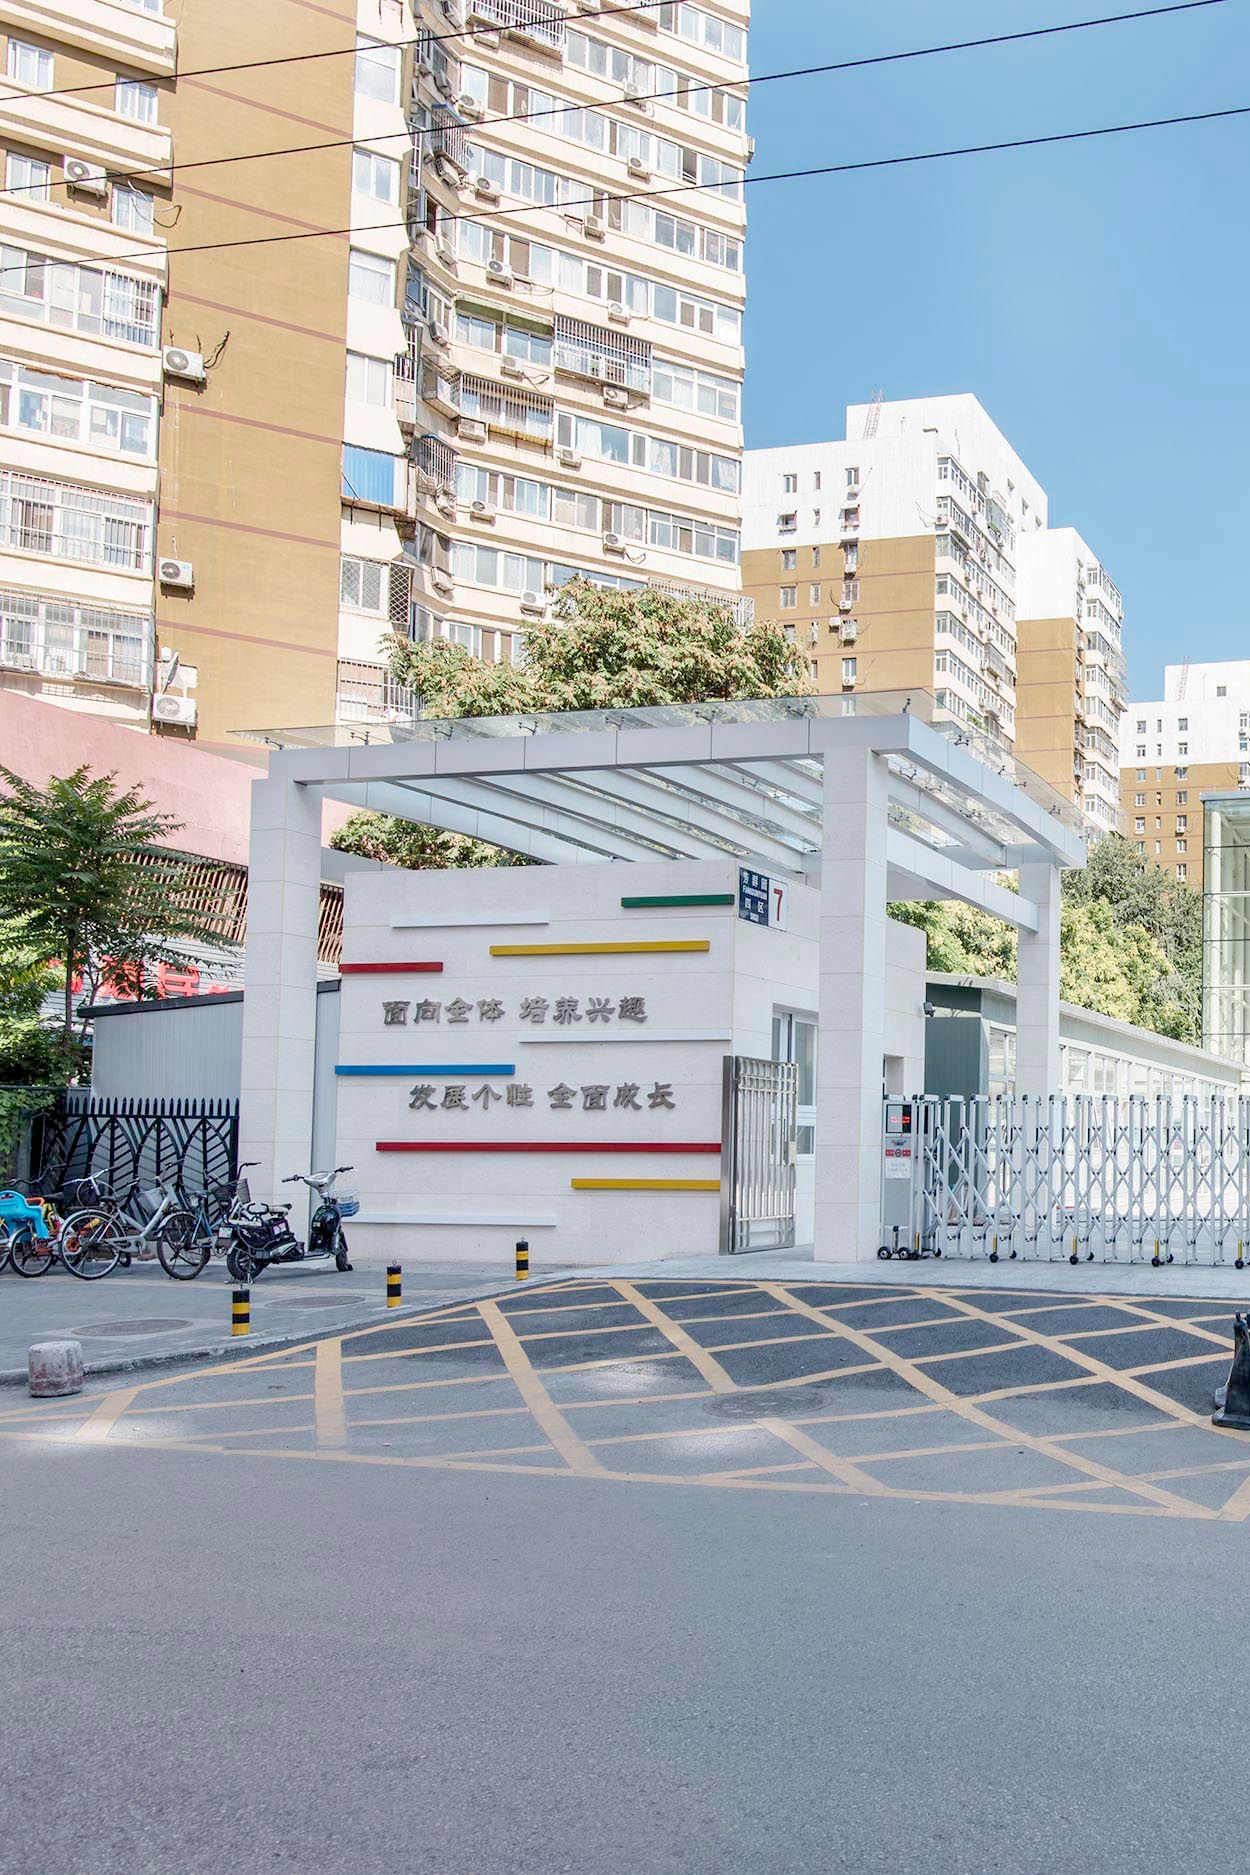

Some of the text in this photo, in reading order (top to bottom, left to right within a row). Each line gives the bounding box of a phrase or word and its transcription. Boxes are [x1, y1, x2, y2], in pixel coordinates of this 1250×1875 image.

[773, 888, 784, 921] 7
[382, 996, 649, 1026] 面向全体 培养兴趣
[408, 1082, 677, 1111] 发展个性 全面成长
